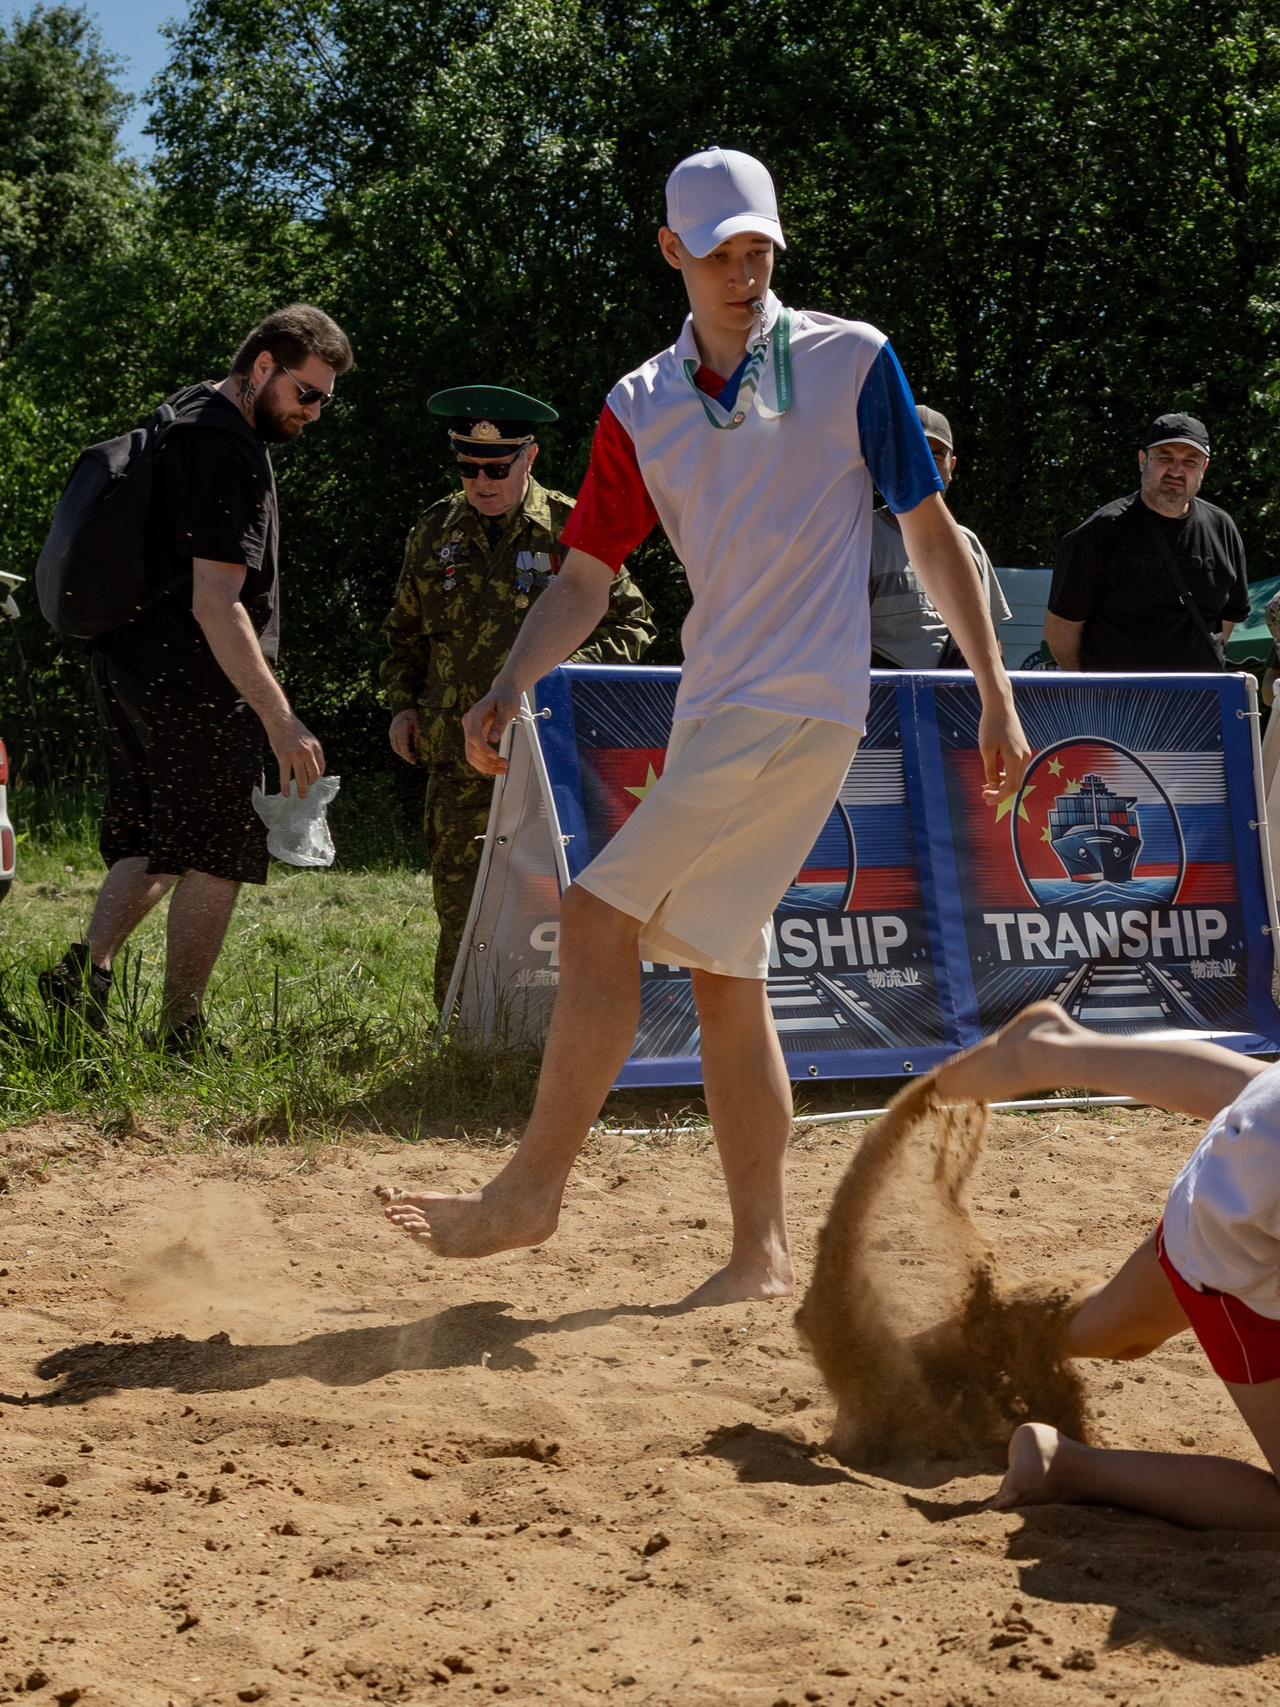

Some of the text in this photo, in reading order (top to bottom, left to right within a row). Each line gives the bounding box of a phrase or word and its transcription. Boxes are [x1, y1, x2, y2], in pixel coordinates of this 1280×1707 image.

[983, 909, 1228, 961] TRANSHIP
[866, 966, 922, 989] 物流业
[1190, 958, 1237, 979] 物流业
